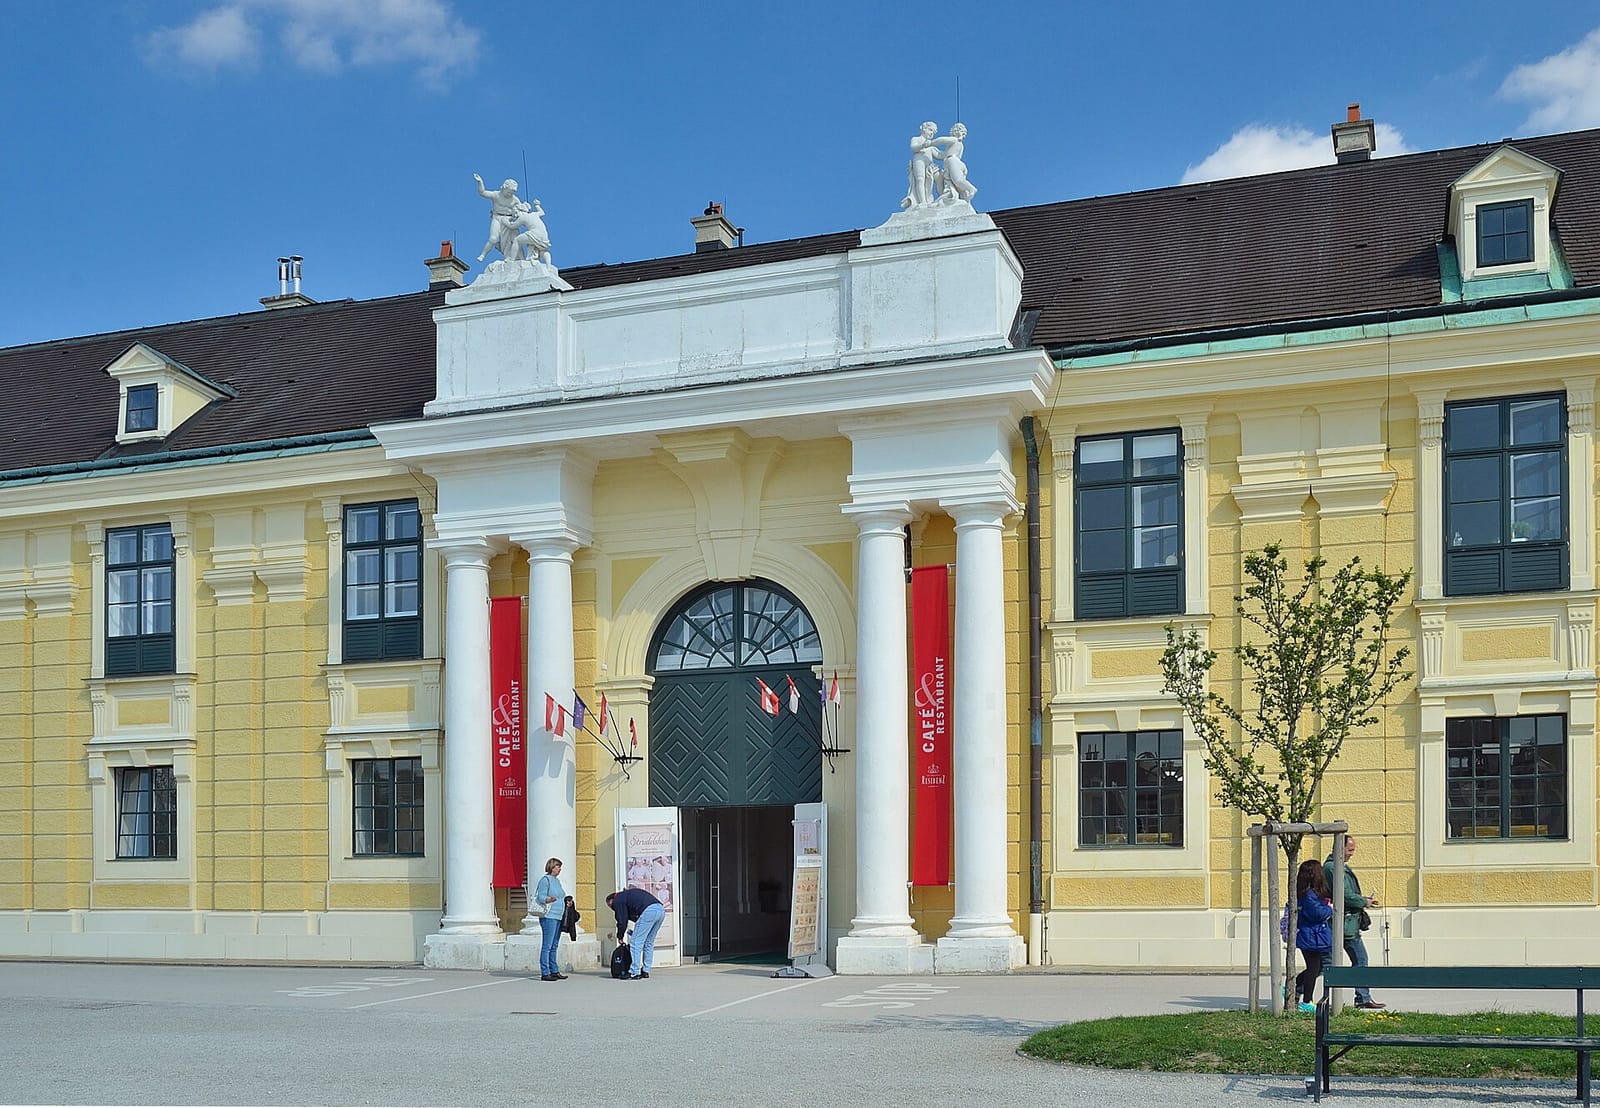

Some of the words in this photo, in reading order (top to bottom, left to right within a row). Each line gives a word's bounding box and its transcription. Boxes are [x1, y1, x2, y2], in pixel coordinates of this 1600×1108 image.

[492, 693, 514, 725] &
[914, 672, 938, 707] &
[935, 656, 945, 734] RESTAURANT
[511, 680, 521, 750] RESTAURANT
[919, 708, 934, 753] CAFÉ
[496, 727, 511, 767] CAFÉ
[820, 982, 961, 1009] STOP
